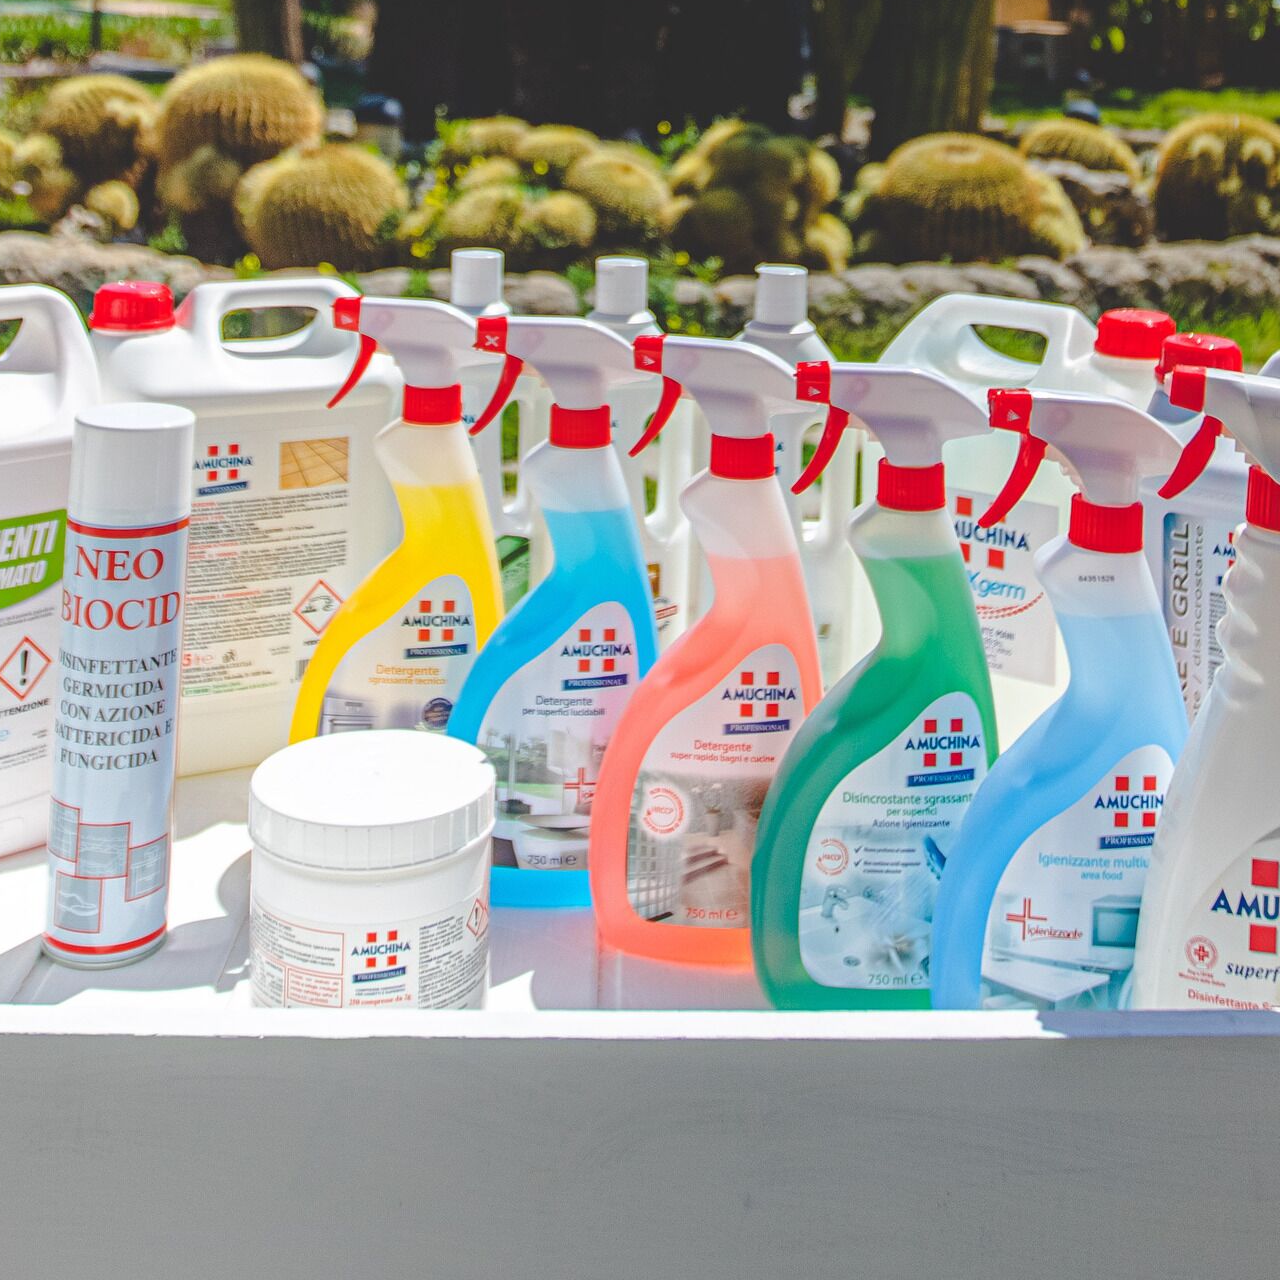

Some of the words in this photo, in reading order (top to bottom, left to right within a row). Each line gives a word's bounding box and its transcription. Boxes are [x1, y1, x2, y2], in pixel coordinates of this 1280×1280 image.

[193, 456, 253, 470] AMUCHINA
[74, 544, 164, 581] NEO
[1172, 521, 1189, 618] GRILL
[1192, 525, 1204, 666] disincrostante
[61, 589, 180, 631] BIOCID
[401, 616, 470, 627] AMUCHINA
[1172, 627, 1188, 650] E
[410, 646, 464, 656] PROFESSIONAL
[560, 644, 632, 656] AMUCHINA
[376, 665, 440, 678] Detergente
[63, 677, 163, 699] GERMICIDA
[568, 677, 624, 687] PROFESSIONAL
[722, 687, 796, 701] AMUCHINA
[535, 695, 593, 708] Detergente
[60, 699, 91, 720] CON
[94, 699, 165, 723] AZIONE
[522, 708, 535, 716] per
[536, 708, 568, 717] superfici
[570, 707, 605, 716] lucidabili
[729, 723, 786, 732] PROFESSIONAL
[693, 740, 752, 753] Detergente
[905, 735, 980, 750] AMUCHINA
[60, 748, 158, 770] FUNGICIDA
[670, 752, 692, 761] super
[693, 752, 719, 762] rapido
[720, 753, 742, 764] bagni
[913, 771, 971, 783] PROFESSIONAL
[842, 792, 921, 805] Disincrostante
[924, 793, 973, 806] sgrassant
[1094, 794, 1164, 809] AMUCHIN
[886, 808, 900, 817] per
[902, 807, 937, 817] superfici
[872, 819, 900, 828] Azione
[1104, 835, 1154, 845] PROFESSION
[527, 854, 547, 865] 750
[549, 854, 563, 865] ml
[1113, 856, 1149, 869] multiu
[1081, 872, 1100, 880] area
[1102, 871, 1124, 880] food
[686, 908, 705, 919] 750
[708, 909, 722, 919] ml
[351, 942, 411, 956] AMUCHINA
[868, 974, 890, 985] 750
[892, 974, 907, 985] ml
